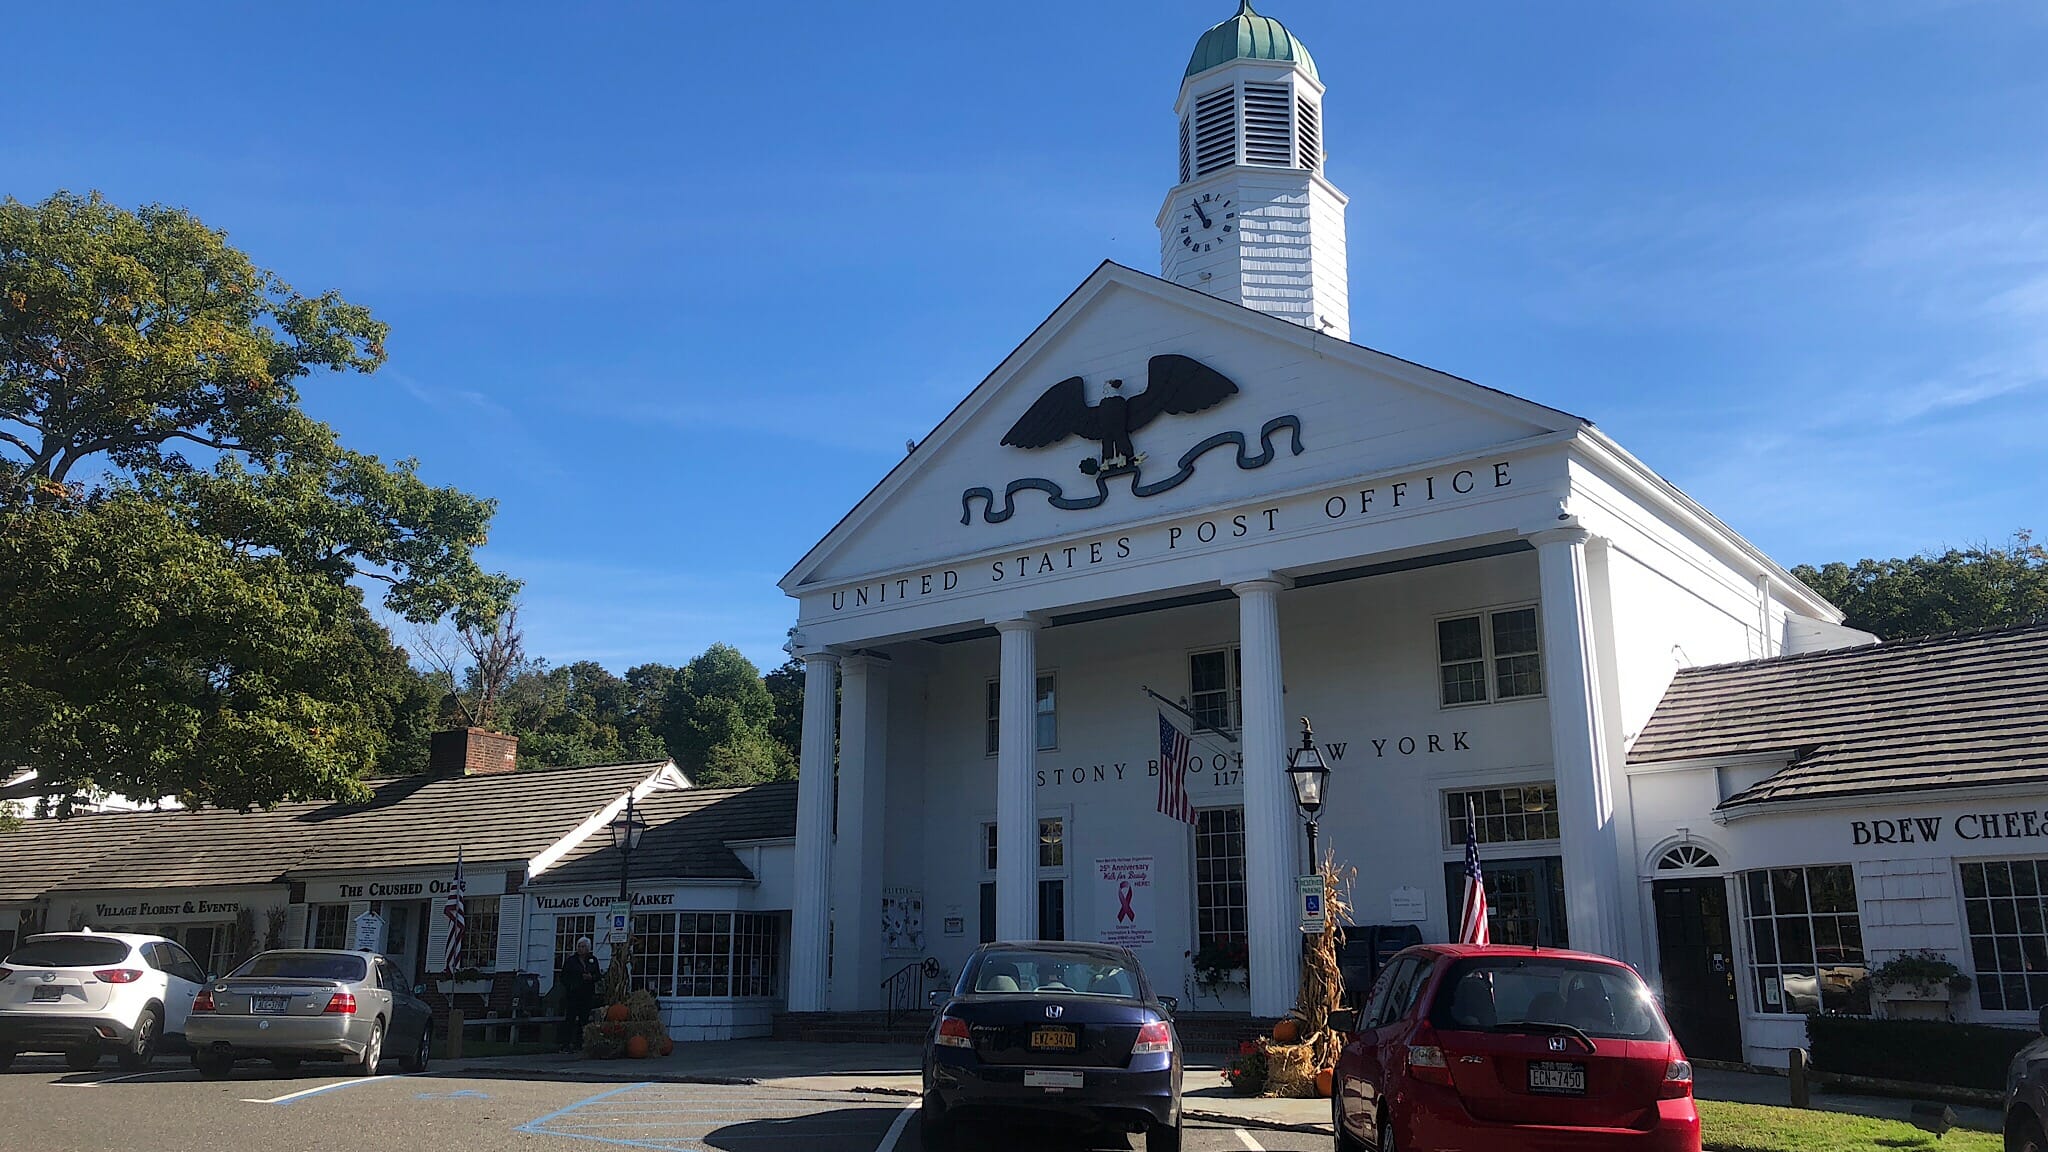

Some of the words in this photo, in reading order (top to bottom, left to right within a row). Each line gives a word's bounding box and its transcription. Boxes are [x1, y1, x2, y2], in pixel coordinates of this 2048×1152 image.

[832, 570, 958, 611] UNITED
[991, 537, 1130, 582] STATES
[1168, 508, 1279, 549] POST
[1325, 462, 1512, 519] OFFICE
[1037, 763, 1127, 787] STONY
[1148, 752, 1244, 777] BOO
[1372, 731, 1471, 758] YORK
[1850, 816, 1943, 845] BREW
[1112, 863, 1149, 872] Anniversary
[340, 884, 363, 898] THE
[369, 882, 423, 897] CRUSHED
[429, 879, 467, 894] OLIE
[96, 904, 137, 917] VILLAGE
[140, 902, 181, 916] FLORIST
[183, 901, 195, 914] &
[198, 900, 239, 913] EVENTS
[536, 896, 580, 909] VILLAGE
